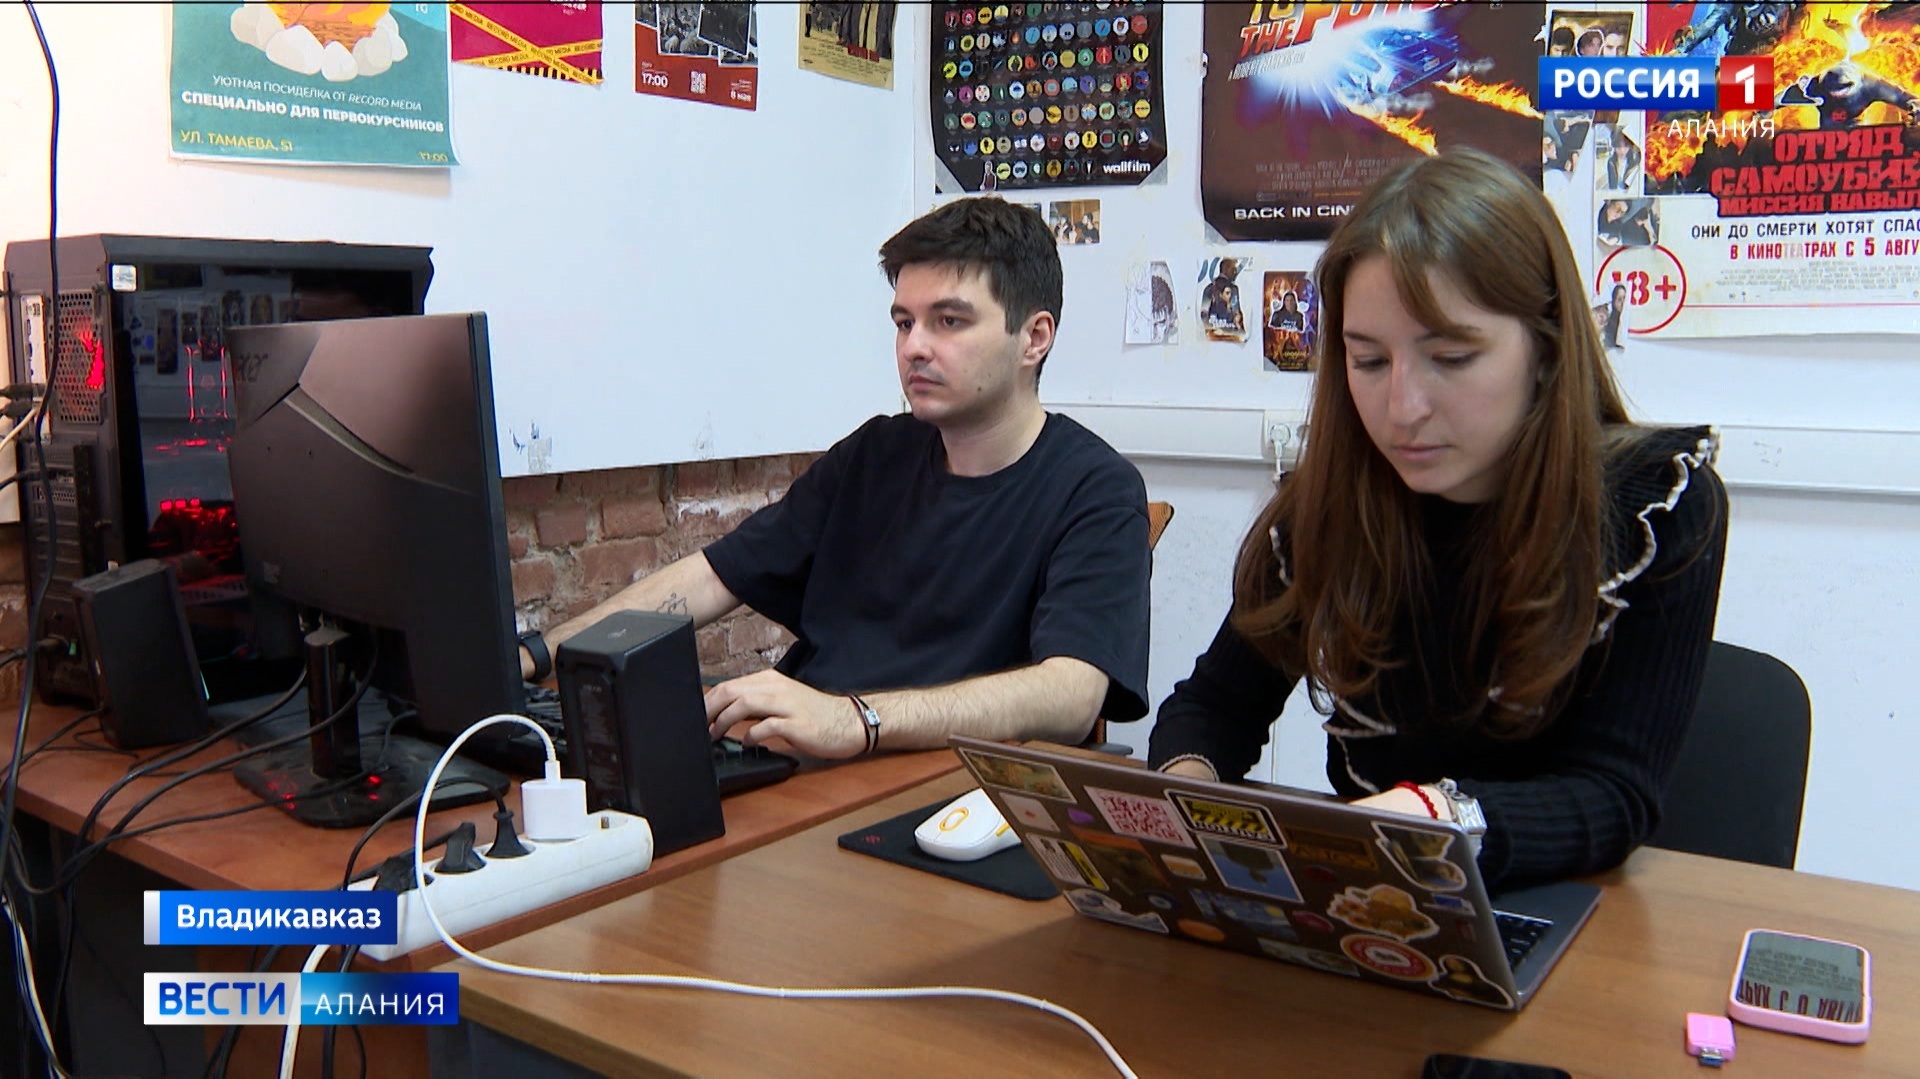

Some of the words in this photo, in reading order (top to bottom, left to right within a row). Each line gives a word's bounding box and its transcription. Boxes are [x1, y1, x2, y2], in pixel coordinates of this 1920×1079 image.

[1240, 18, 1297, 58] THE
[642, 73, 668, 88] 17:00
[213, 74, 261, 90] УЮТНАЯ
[263, 83, 330, 100] ПОСИДЕЛКА
[333, 92, 346, 102] ОТ
[390, 99, 423, 112] MEDIA
[181, 91, 287, 115] СПЕЦИАЛЬНО
[290, 105, 320, 119] ДЛЯ
[323, 110, 444, 133] ПЕРВОКУРСНИКОВ
[180, 130, 204, 144] УЛ.
[207, 133, 278, 151] ТАМАЕВА,
[1774, 126, 1904, 162] ОТРЯД
[1103, 160, 1151, 175] wallfilm
[1234, 206, 1285, 220] BACK
[1292, 205, 1311, 217] IN
[1719, 194, 1825, 216] МИССИЯ
[1691, 225, 1720, 239] ОНИ
[1728, 224, 1749, 239] ДО
[1756, 223, 1816, 237] СМЕРТИ
[1825, 219, 1875, 234] ХОТЯТ
[1730, 245, 1739, 260] В
[1748, 241, 1836, 260] КИНОТЕАТРАХ
[1846, 241, 1854, 256] С
[1864, 237, 1875, 256] 5
